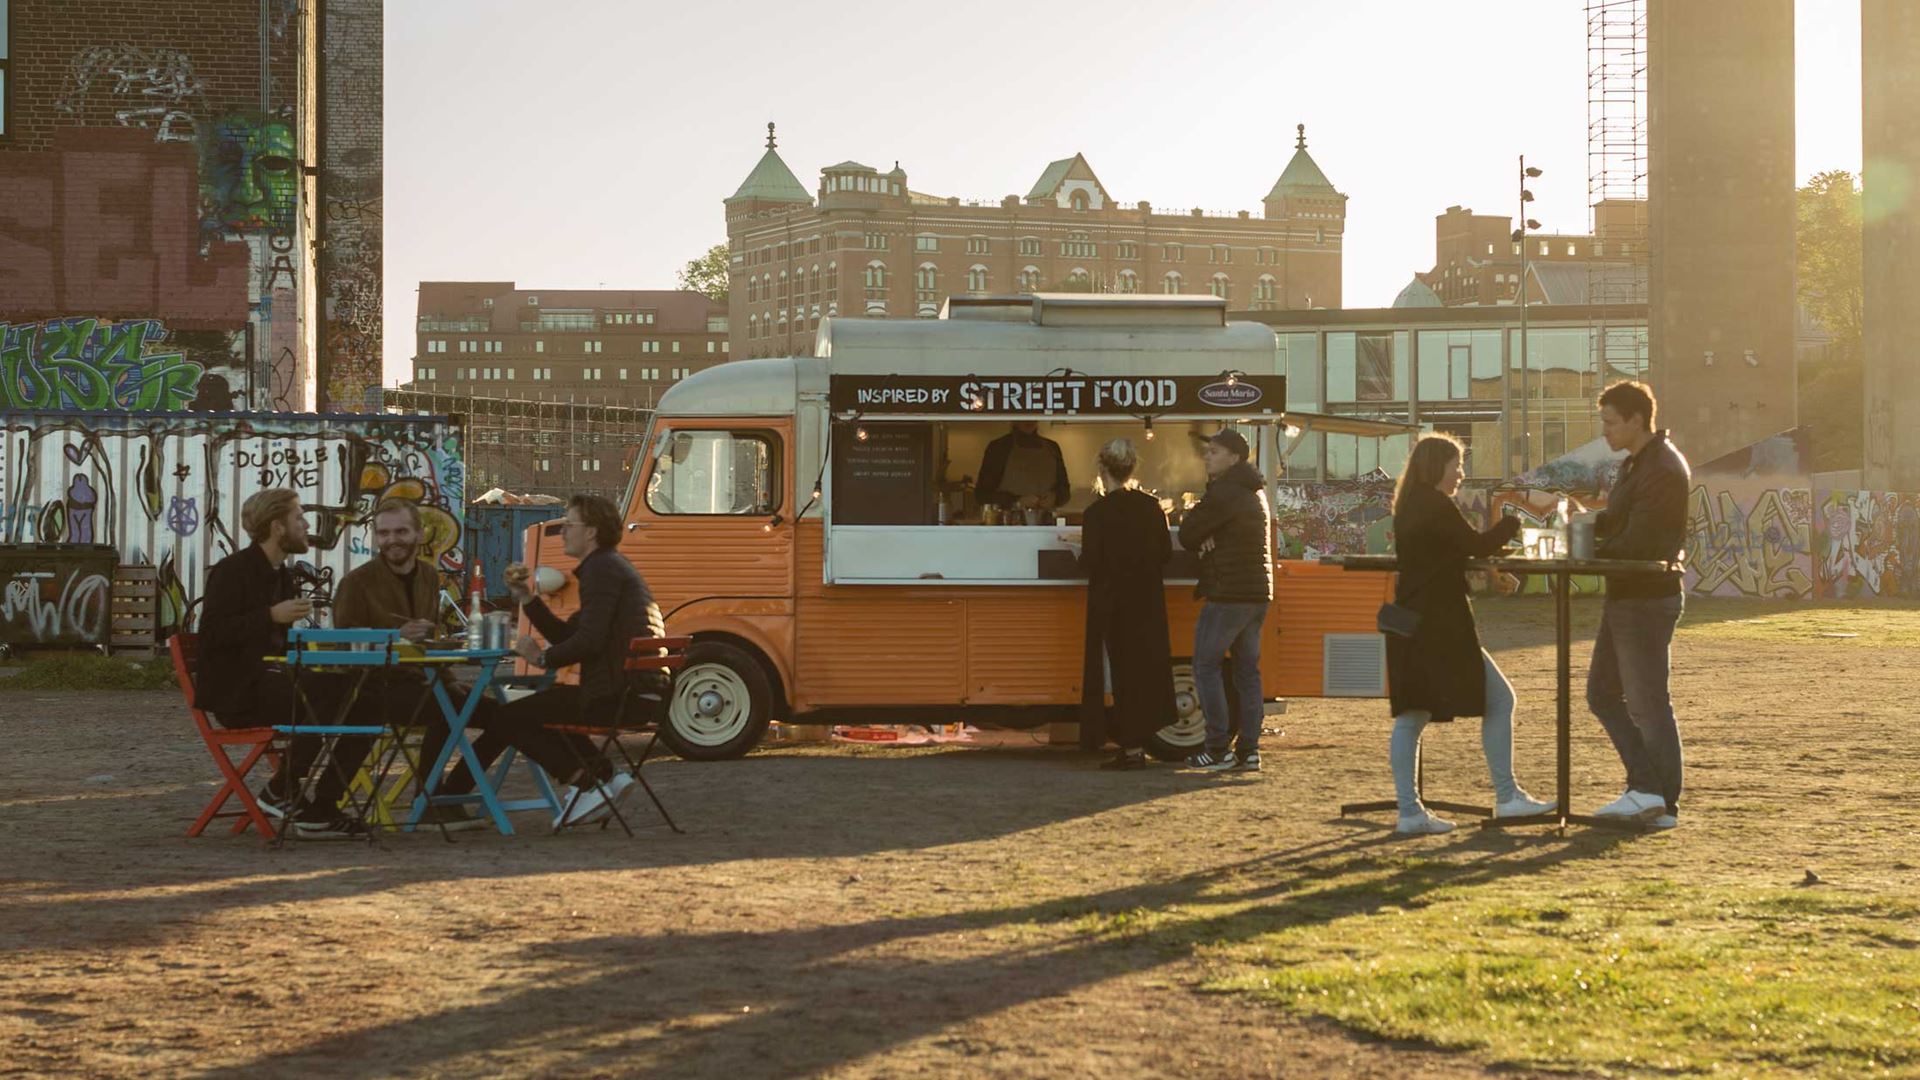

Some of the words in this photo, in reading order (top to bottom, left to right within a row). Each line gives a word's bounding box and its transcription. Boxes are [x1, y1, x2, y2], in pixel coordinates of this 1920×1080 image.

[857, 388, 929, 404] INSPIRED
[932, 388, 950, 404] BY
[959, 381, 1086, 410] STREET
[1094, 379, 1177, 407] FOOD
[1204, 389, 1229, 398] Santa
[1230, 388, 1255, 398] Maria
[261, 467, 320, 489] DYKE
